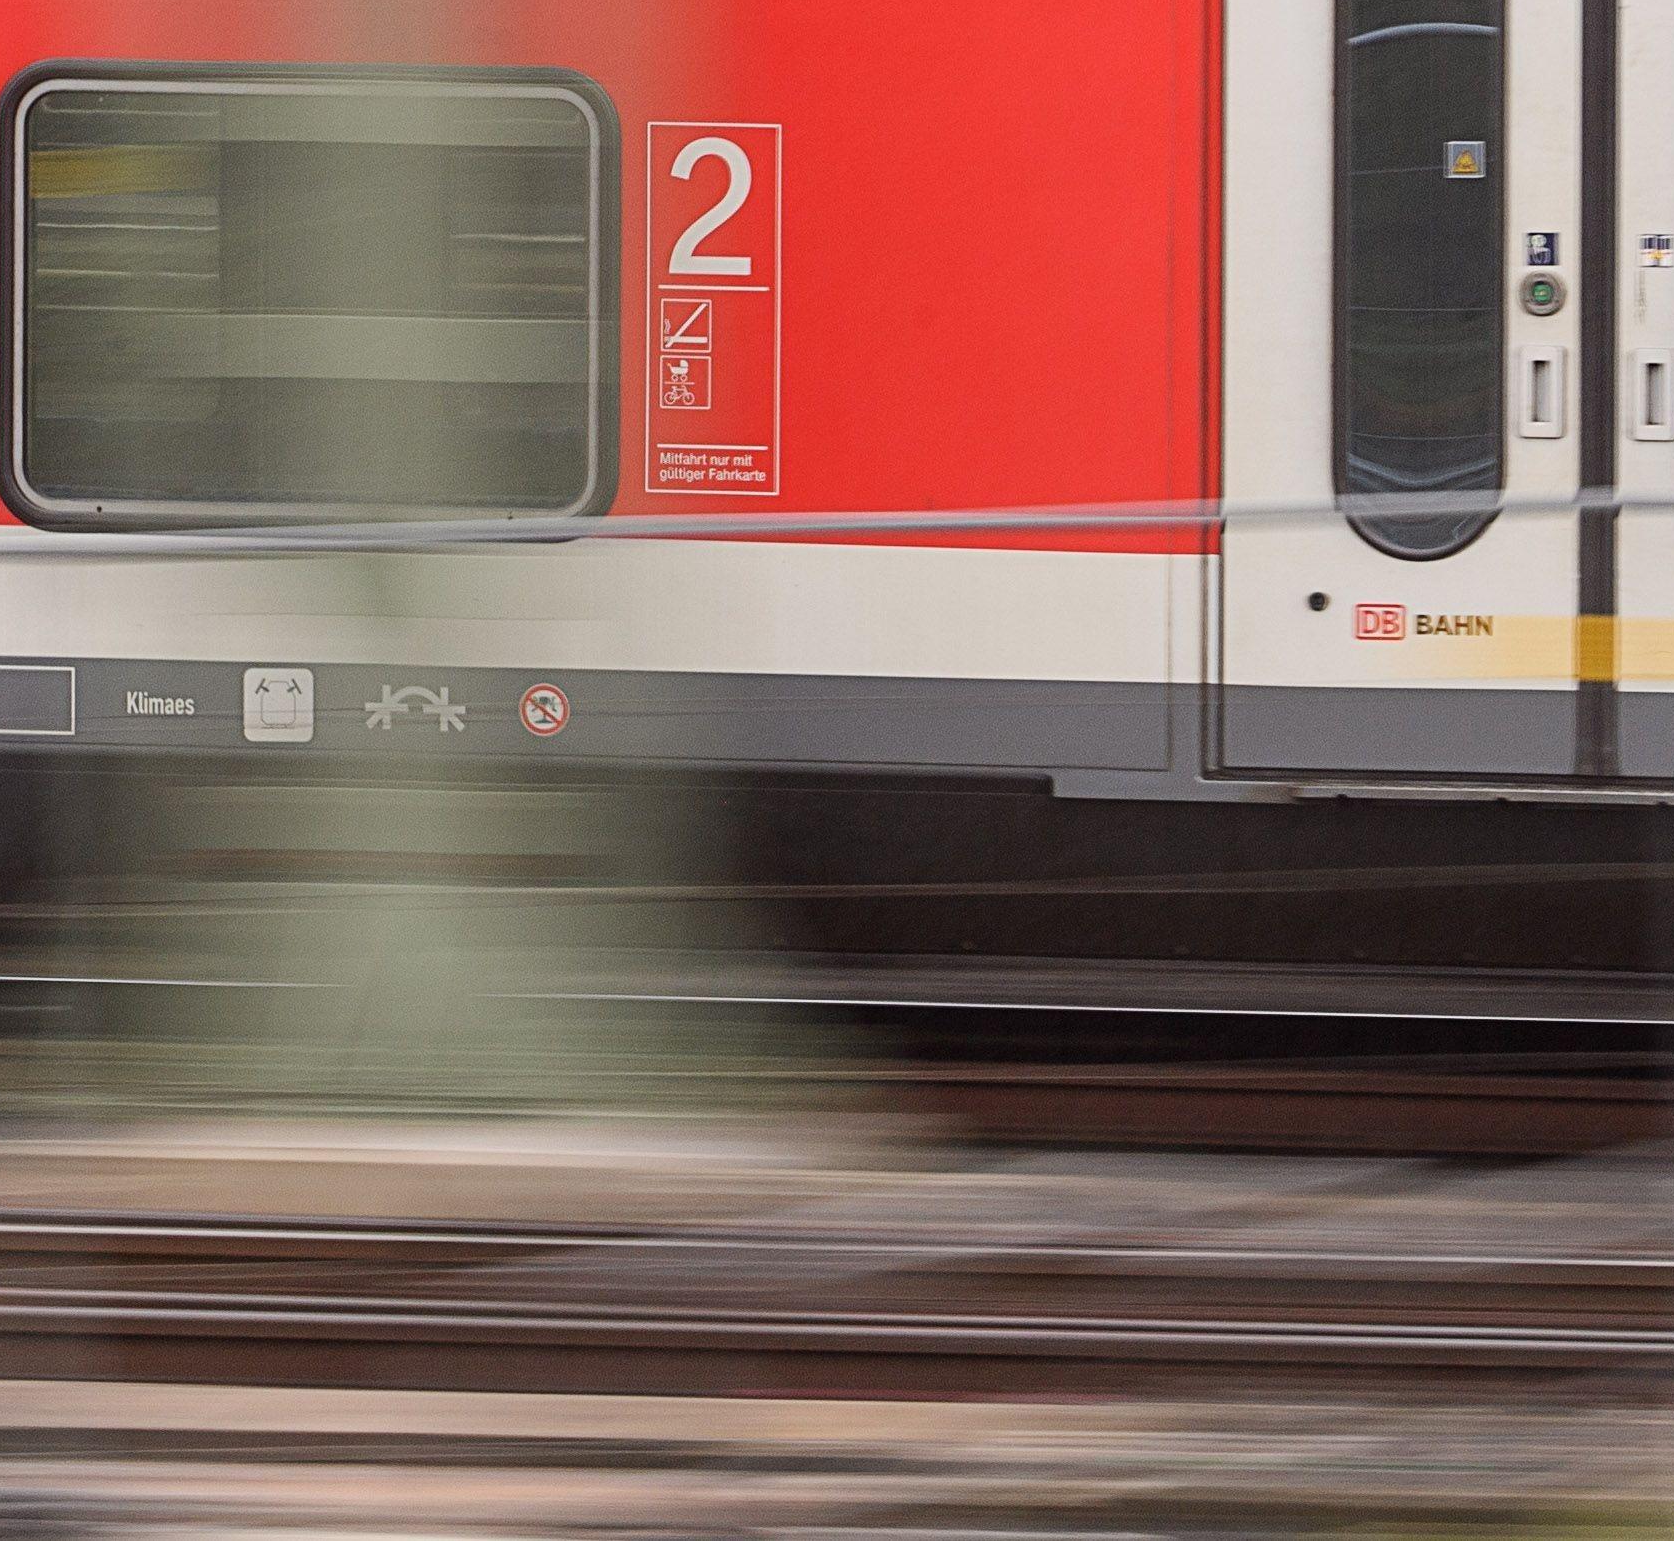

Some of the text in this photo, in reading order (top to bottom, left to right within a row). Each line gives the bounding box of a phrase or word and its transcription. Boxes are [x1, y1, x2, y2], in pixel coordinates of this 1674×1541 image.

[668, 136, 752, 276] 2
[659, 452, 753, 467] Mitfahrt nur mit
[659, 467, 766, 482] gültiger Fahrkarte
[1360, 609, 1494, 636] DB BAHN
[126, 691, 195, 715] Klimaes
